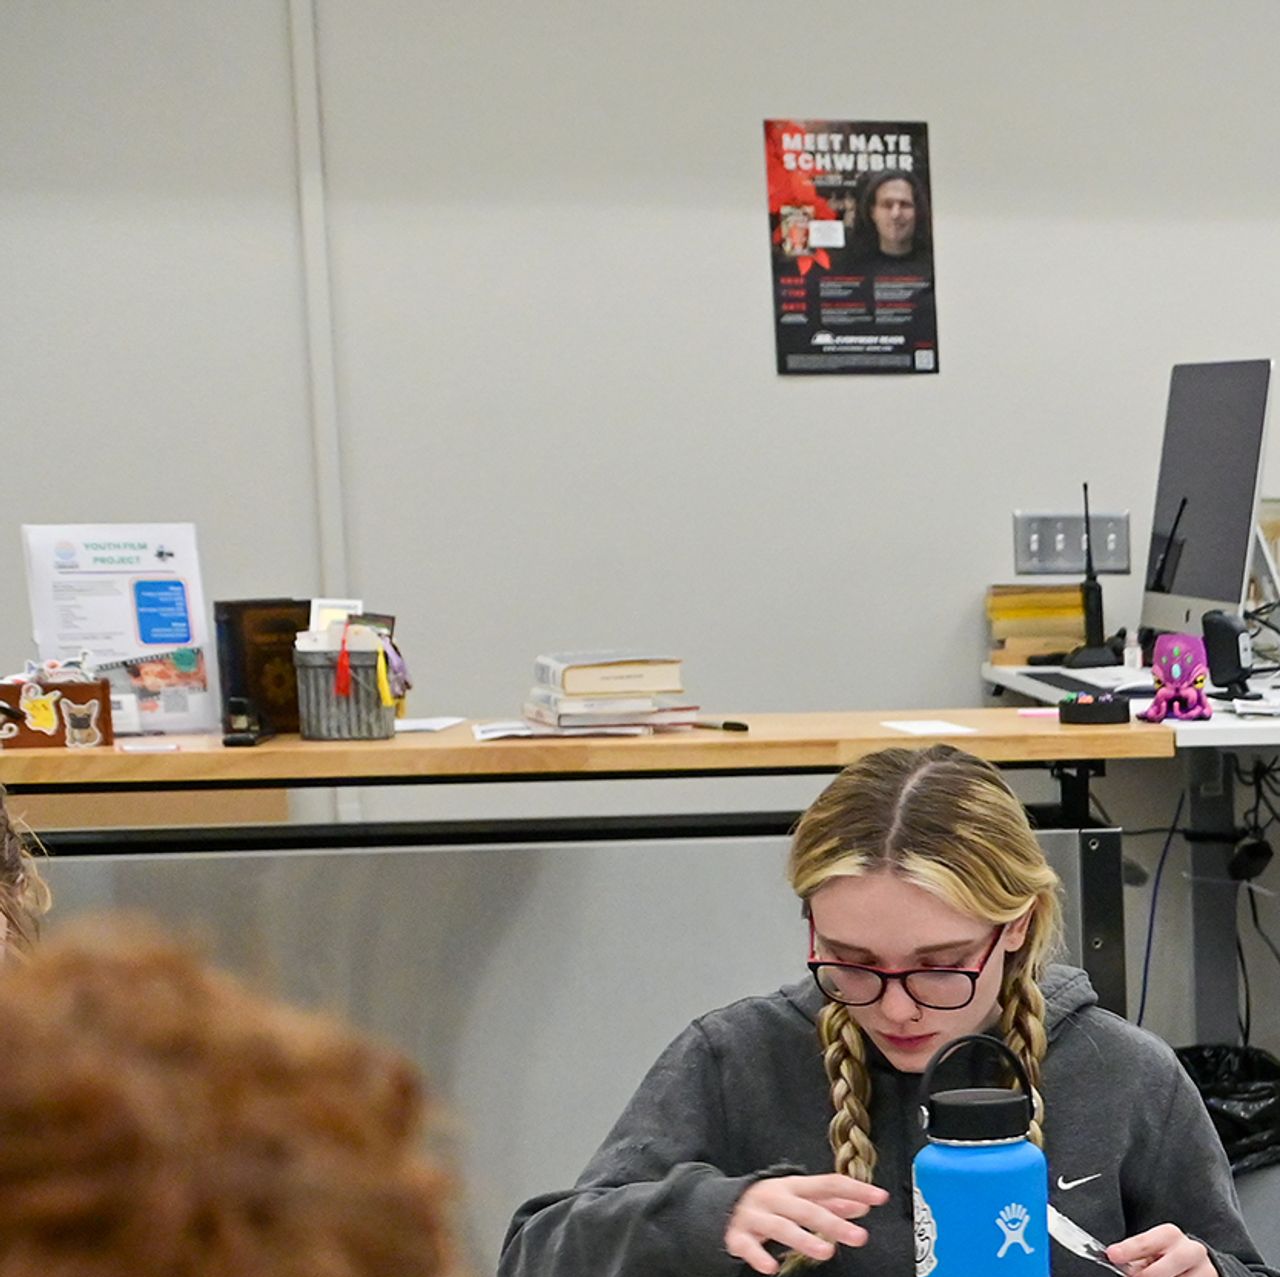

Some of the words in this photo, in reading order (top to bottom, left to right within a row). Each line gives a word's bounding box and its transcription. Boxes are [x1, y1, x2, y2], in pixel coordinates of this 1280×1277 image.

[782, 133, 843, 151] MEET
[850, 134, 911, 152] NATE
[783, 153, 913, 172] SCHWEBER
[83, 543, 121, 551] YOUTH
[122, 542, 148, 550] FILM
[93, 556, 141, 564] PROJECT
